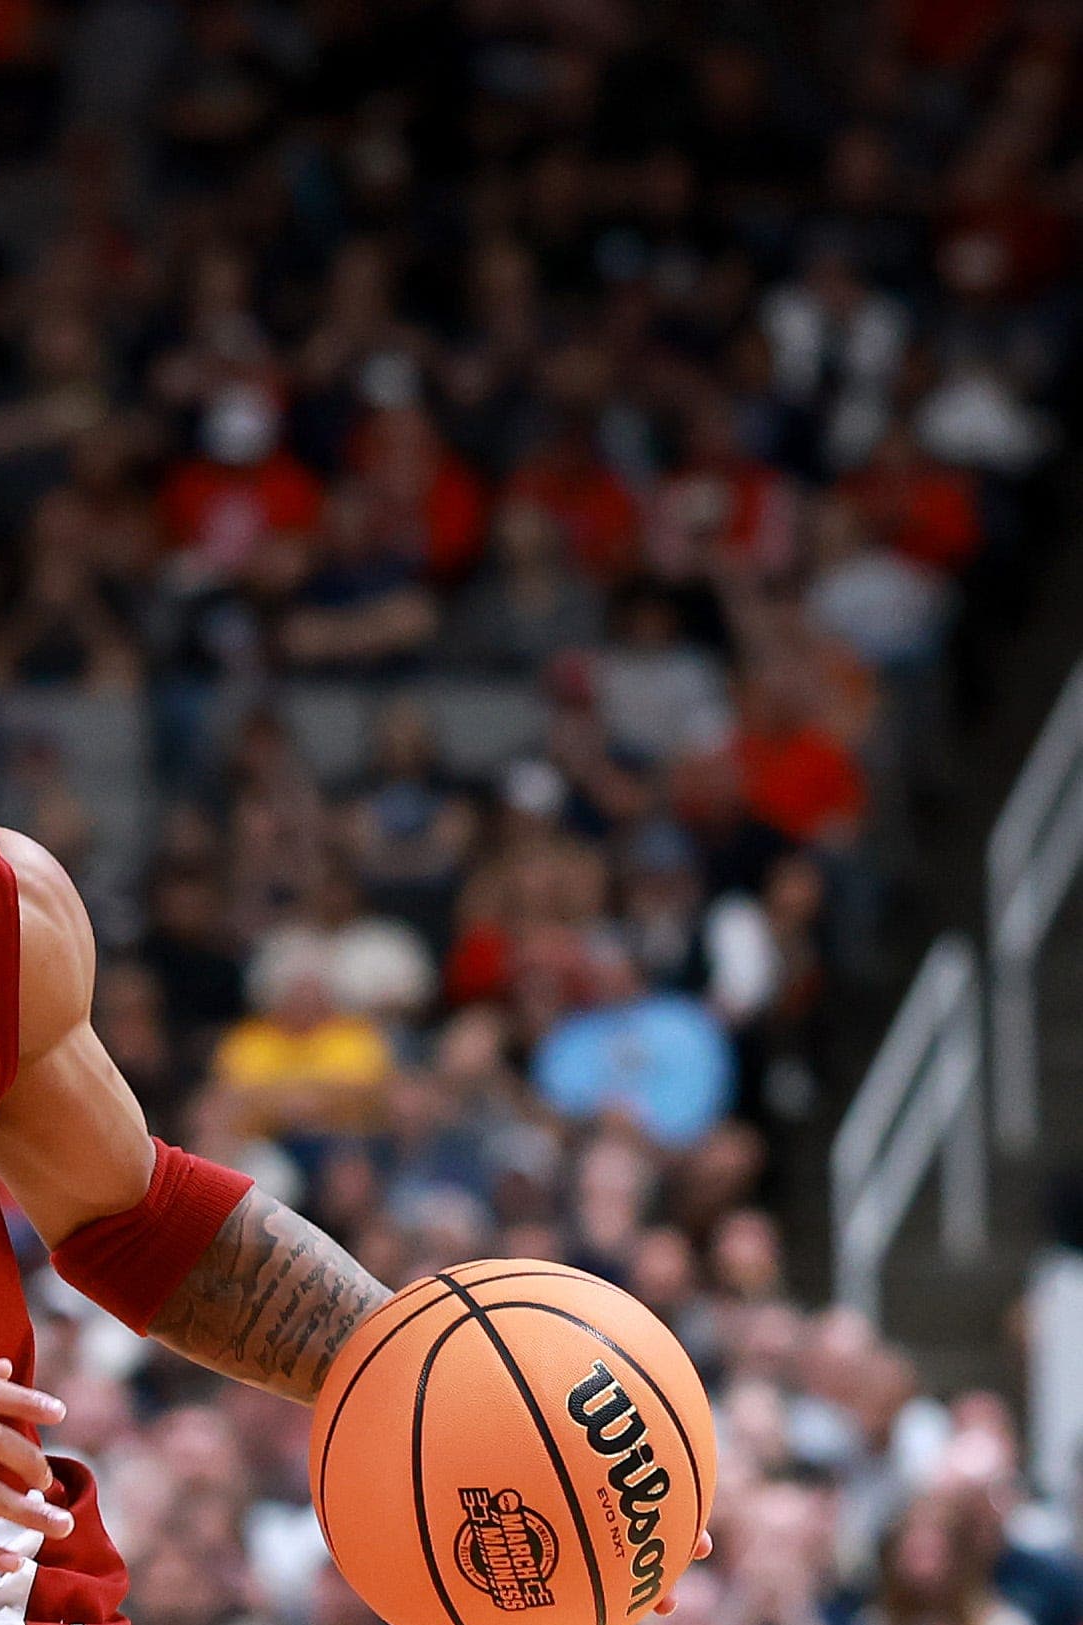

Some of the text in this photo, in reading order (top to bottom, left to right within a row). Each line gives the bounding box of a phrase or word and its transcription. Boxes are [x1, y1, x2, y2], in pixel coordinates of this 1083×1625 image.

[566, 1358, 671, 1617] Wilson
[596, 1486, 626, 1559] EVO NXT
[479, 1526, 527, 1609] MADNESS
[499, 1512, 540, 1579] MARCH
